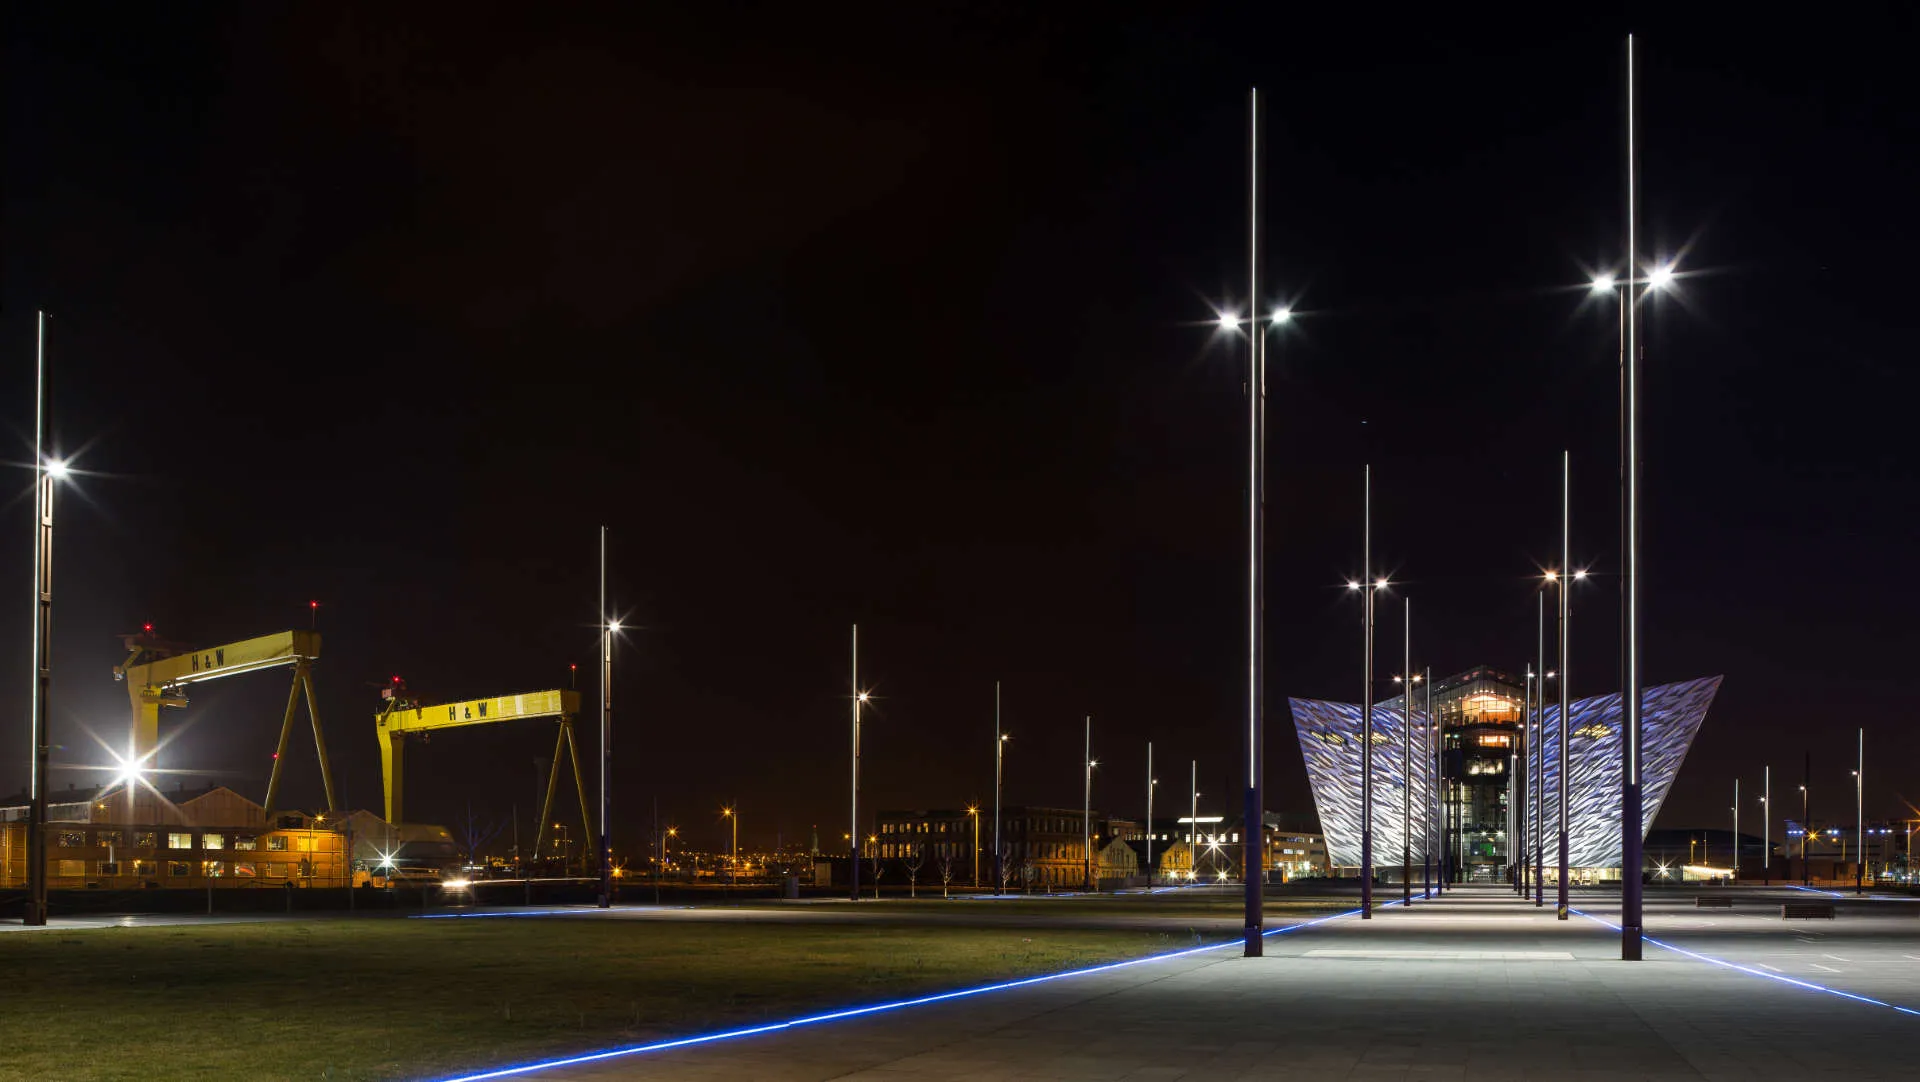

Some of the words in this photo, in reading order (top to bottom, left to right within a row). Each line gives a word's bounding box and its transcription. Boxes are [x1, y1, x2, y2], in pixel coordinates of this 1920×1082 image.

[191, 655, 199, 672] H
[205, 655, 212, 669] &
[215, 648, 224, 666] W
[448, 706, 456, 720] H
[464, 706, 472, 719] &
[478, 702, 488, 717] W
